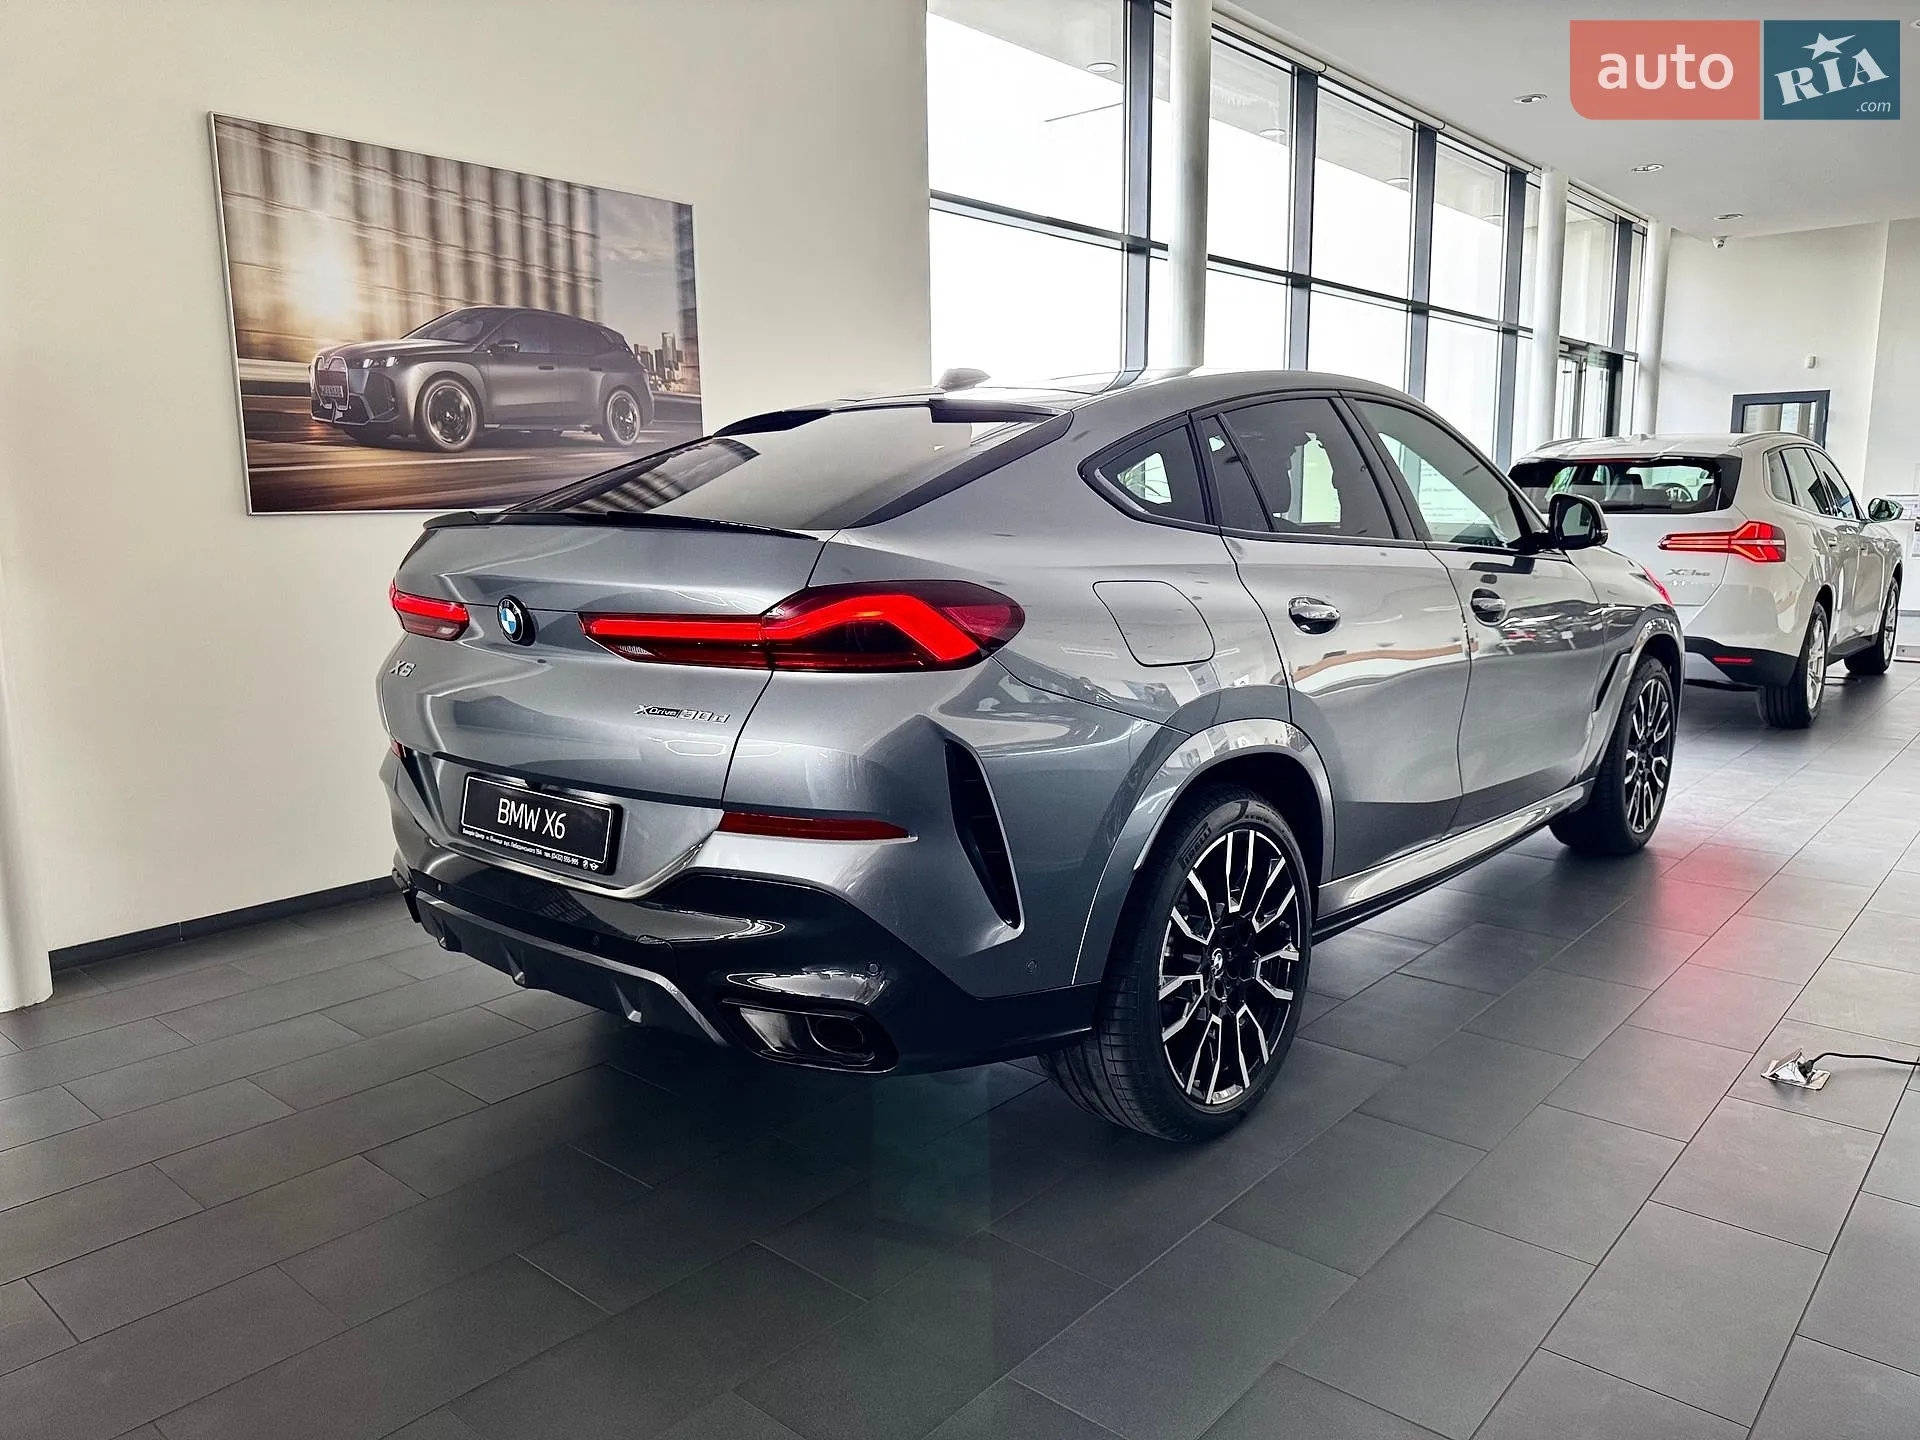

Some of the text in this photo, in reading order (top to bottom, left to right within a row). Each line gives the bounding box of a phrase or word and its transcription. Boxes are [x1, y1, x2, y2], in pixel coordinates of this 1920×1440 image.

[389, 660, 417, 678] X6
[497, 798, 567, 840] BMW X6
